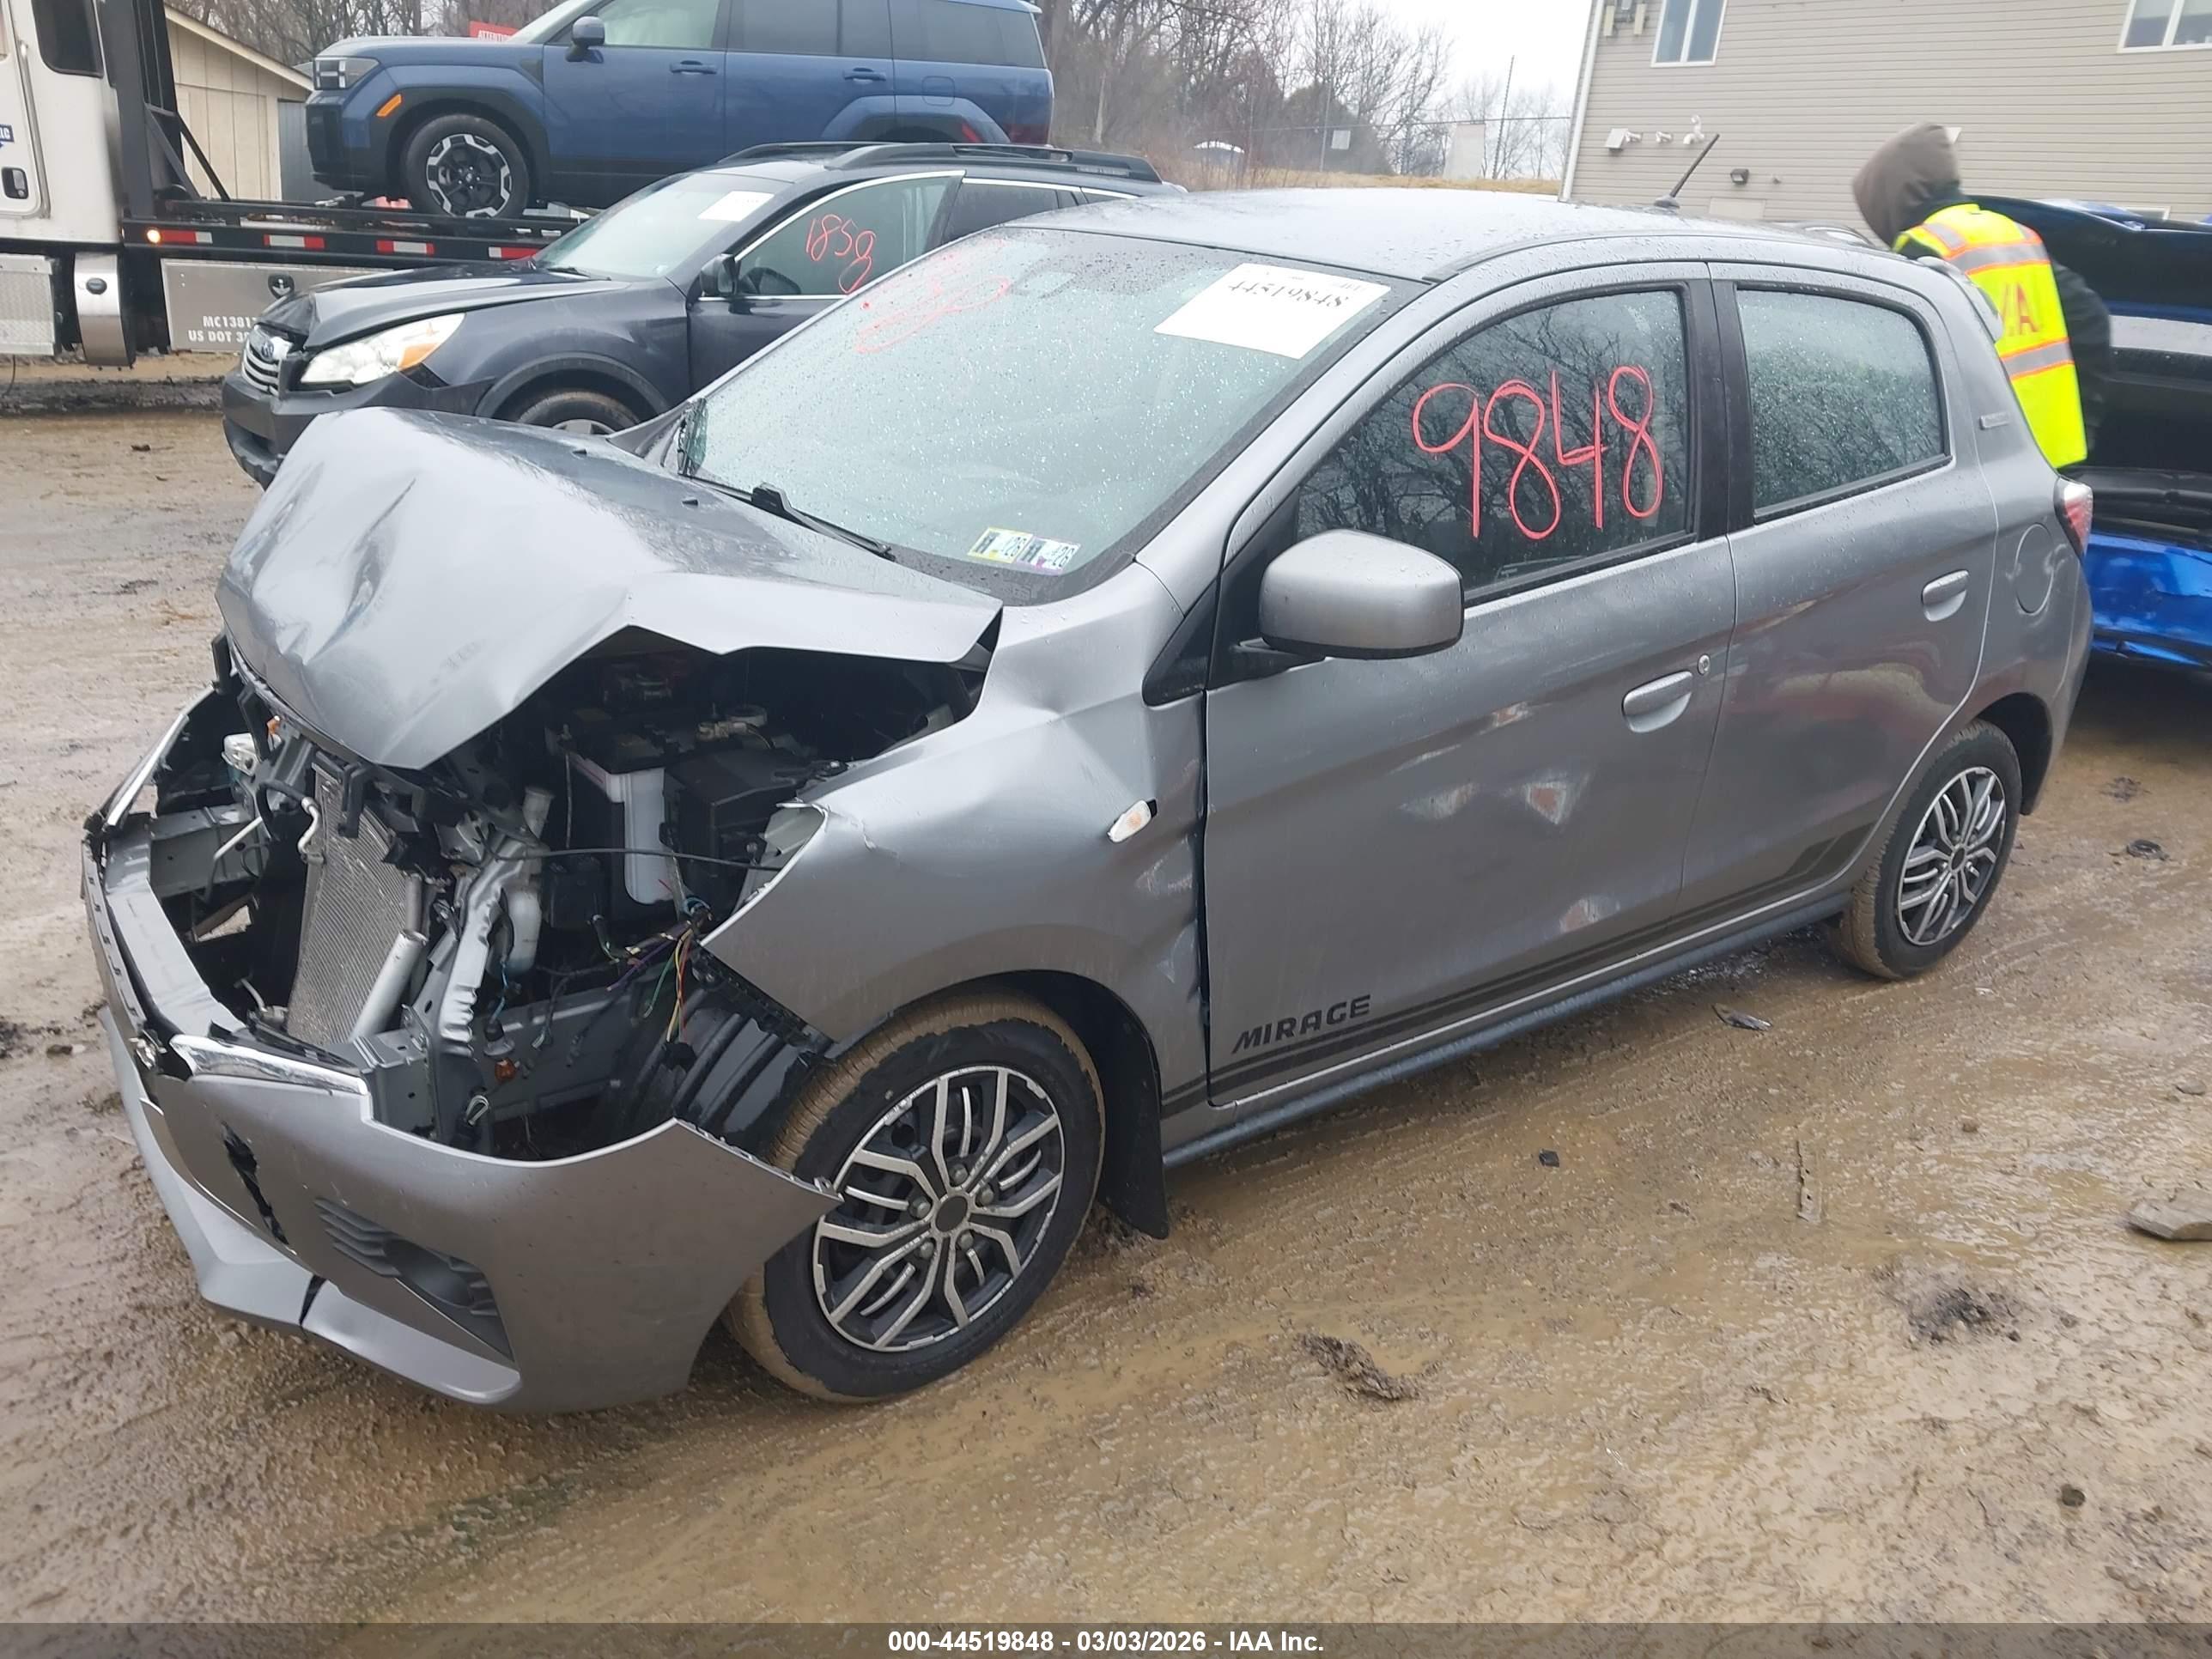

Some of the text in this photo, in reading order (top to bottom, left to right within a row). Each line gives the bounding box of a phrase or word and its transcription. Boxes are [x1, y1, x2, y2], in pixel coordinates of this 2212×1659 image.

[1228, 281, 1349, 307] 44519848
[188, 330, 204, 342] US
[208, 331, 232, 343] DOT
[1413, 364, 1662, 539] 9848
[1231, 994, 1371, 1054] MIRAGE
